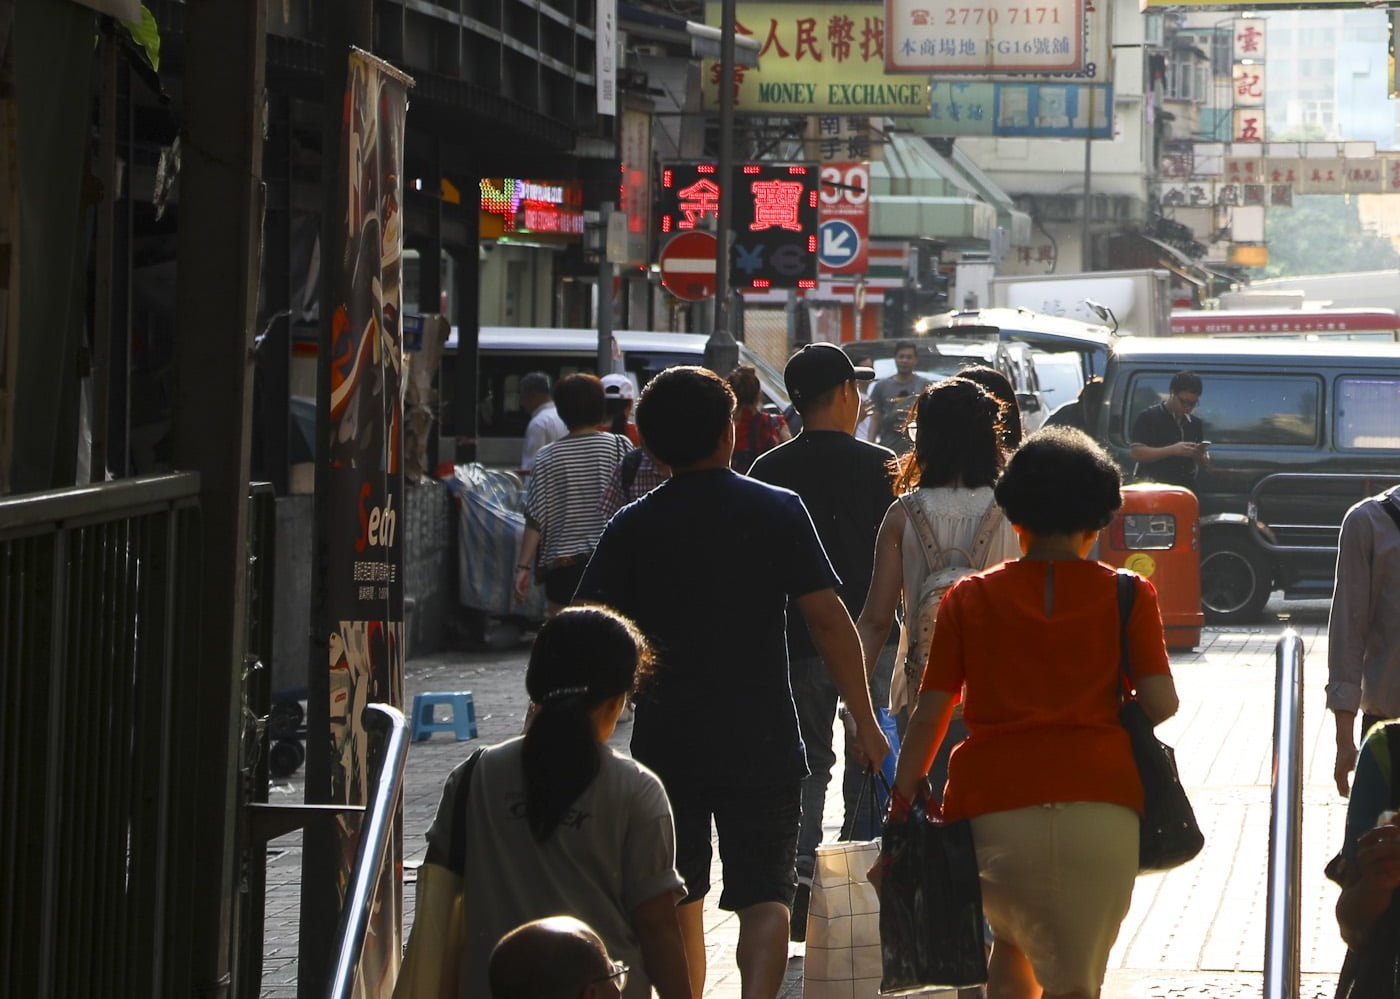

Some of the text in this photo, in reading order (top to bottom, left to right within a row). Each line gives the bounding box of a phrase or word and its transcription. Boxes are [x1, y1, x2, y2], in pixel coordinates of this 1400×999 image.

[945, 7, 1061, 25] 2770 7171
[758, 82, 921, 106] MONEY EXCHANGE
[821, 166, 868, 205] 30
